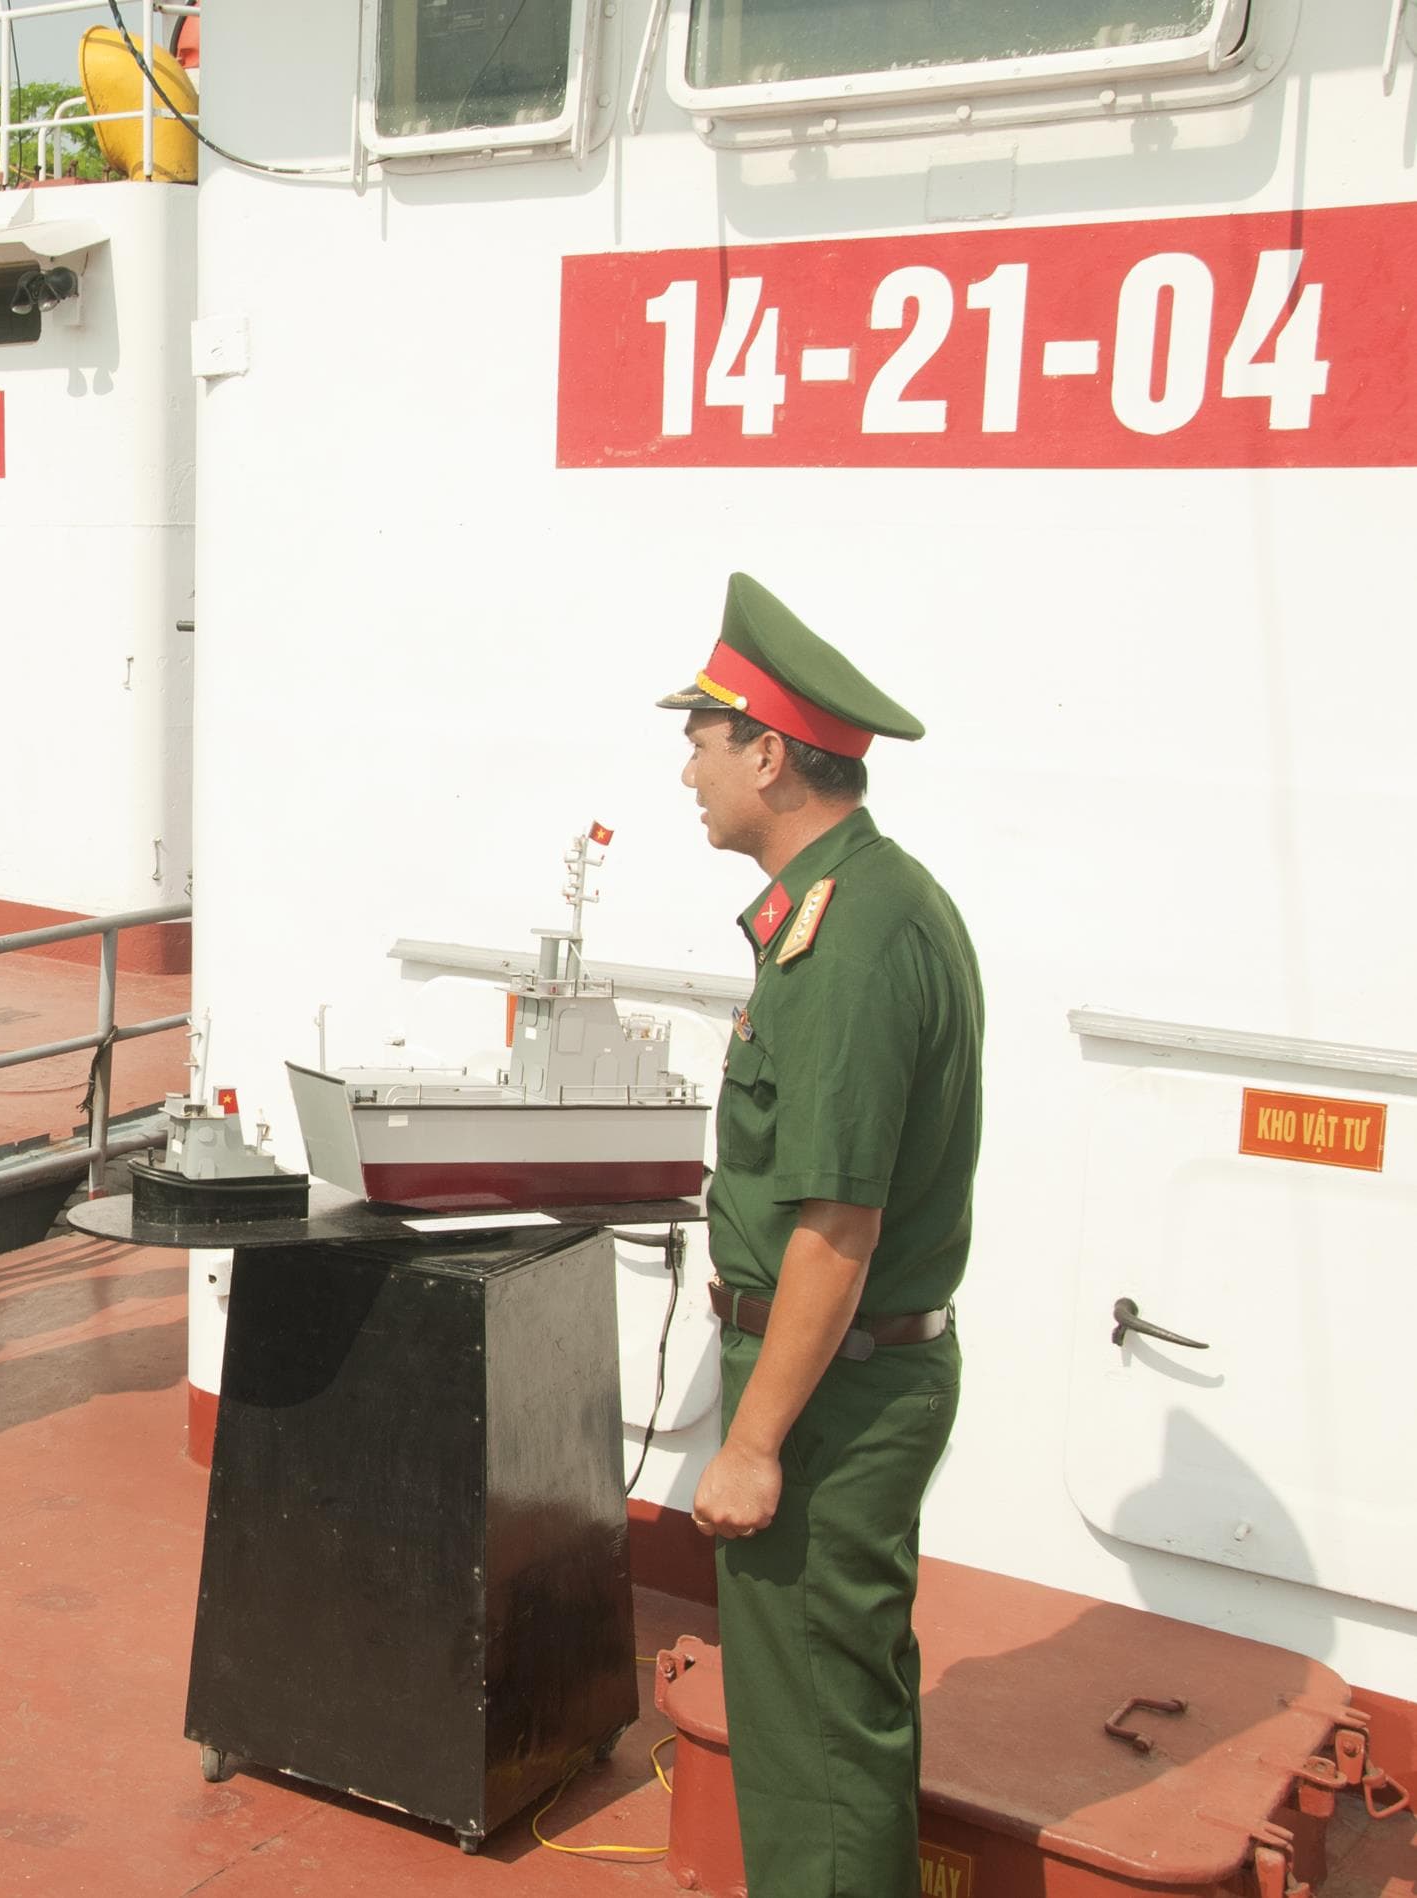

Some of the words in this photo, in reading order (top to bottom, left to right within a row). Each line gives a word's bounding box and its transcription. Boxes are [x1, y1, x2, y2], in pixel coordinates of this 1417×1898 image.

[644, 248, 1331, 437] 14-21-04
[1257, 1106, 1296, 1143] KHO
[1302, 1107, 1339, 1153] VẬT
[1343, 1116, 1371, 1152] TƯ
